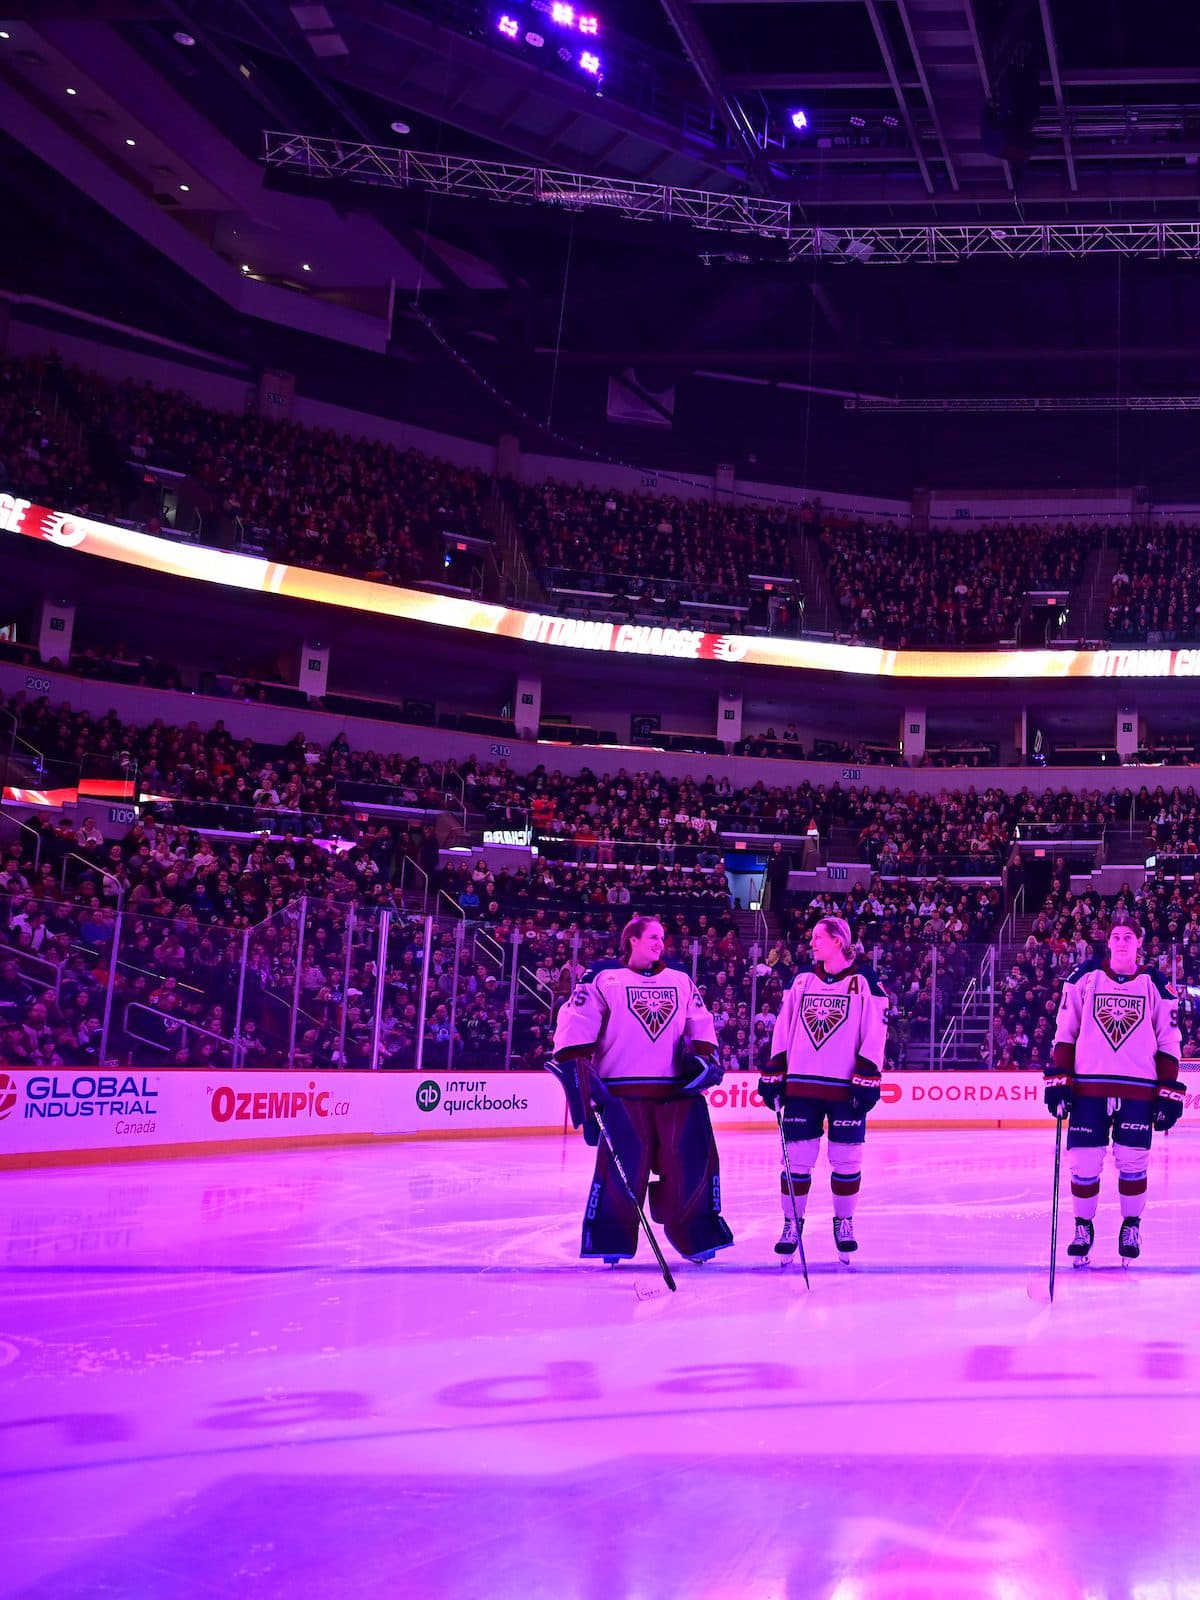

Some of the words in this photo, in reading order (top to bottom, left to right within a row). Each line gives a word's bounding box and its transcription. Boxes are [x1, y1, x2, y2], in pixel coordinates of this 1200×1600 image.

[524, 613, 614, 650] OTTAWA
[615, 624, 704, 658] CHARGE
[1094, 649, 1171, 677] OTTAWA
[26, 677, 51, 692] 209
[490, 744, 511, 756] 210
[842, 769, 860, 779] 211
[111, 809, 135, 823] 109
[849, 976, 859, 994] A
[631, 989, 674, 1003] VICTOIRE
[804, 997, 846, 1012] VICTOIRE
[1097, 997, 1141, 1012] VICTOIRE
[26, 1077, 158, 1100] GLOBAL
[445, 1081, 486, 1093] INTUIT
[912, 1085, 1037, 1102] DOORDASH
[24, 1101, 157, 1119] INDUSTRIAL
[443, 1094, 528, 1116] quickbooks
[115, 1120, 156, 1135] Canada
[1121, 1123, 1149, 1131] CCM
[713, 1176, 721, 1211] CCM
[587, 1184, 602, 1220] CCM
